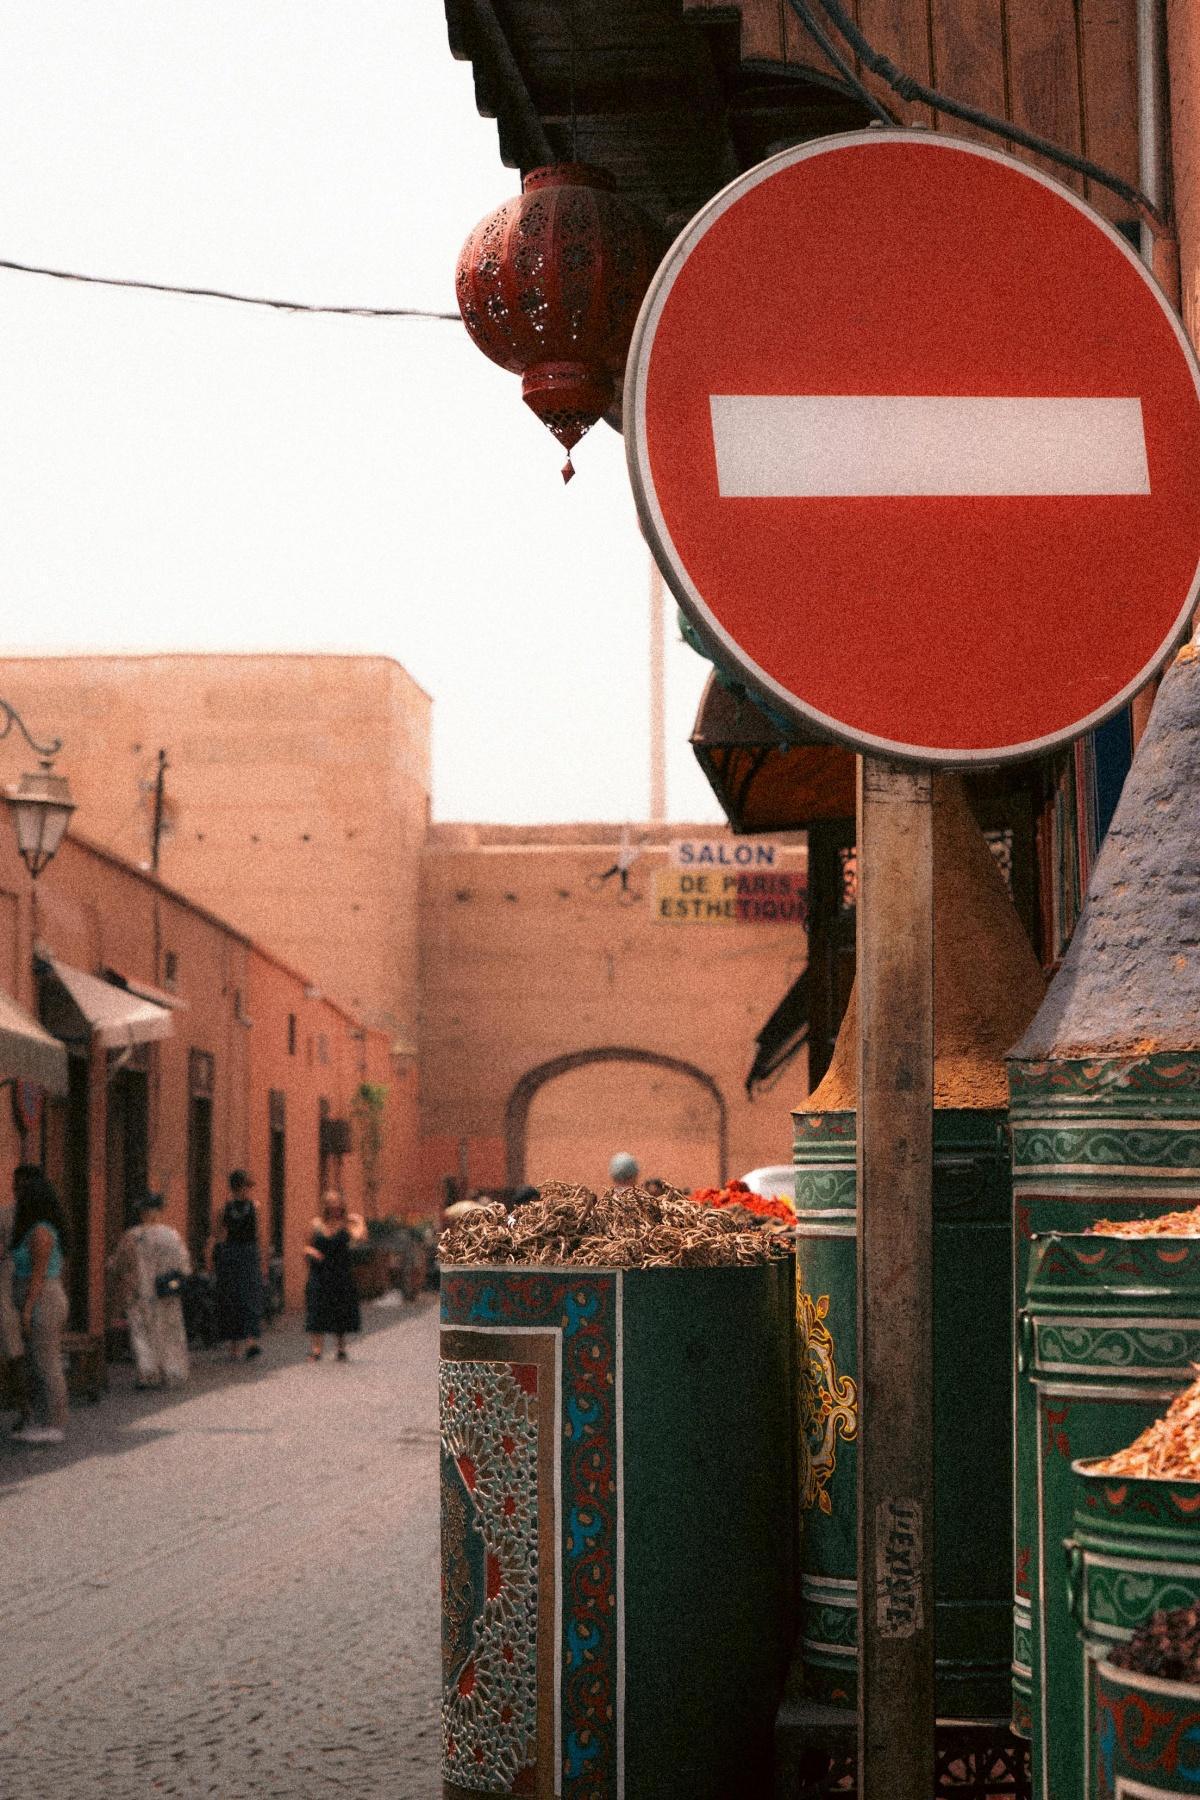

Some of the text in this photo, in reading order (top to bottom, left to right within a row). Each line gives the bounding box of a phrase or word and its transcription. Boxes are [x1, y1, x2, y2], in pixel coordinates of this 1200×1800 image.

[680, 844, 775, 865] SALON
[680, 874, 792, 894] DE PARIS
